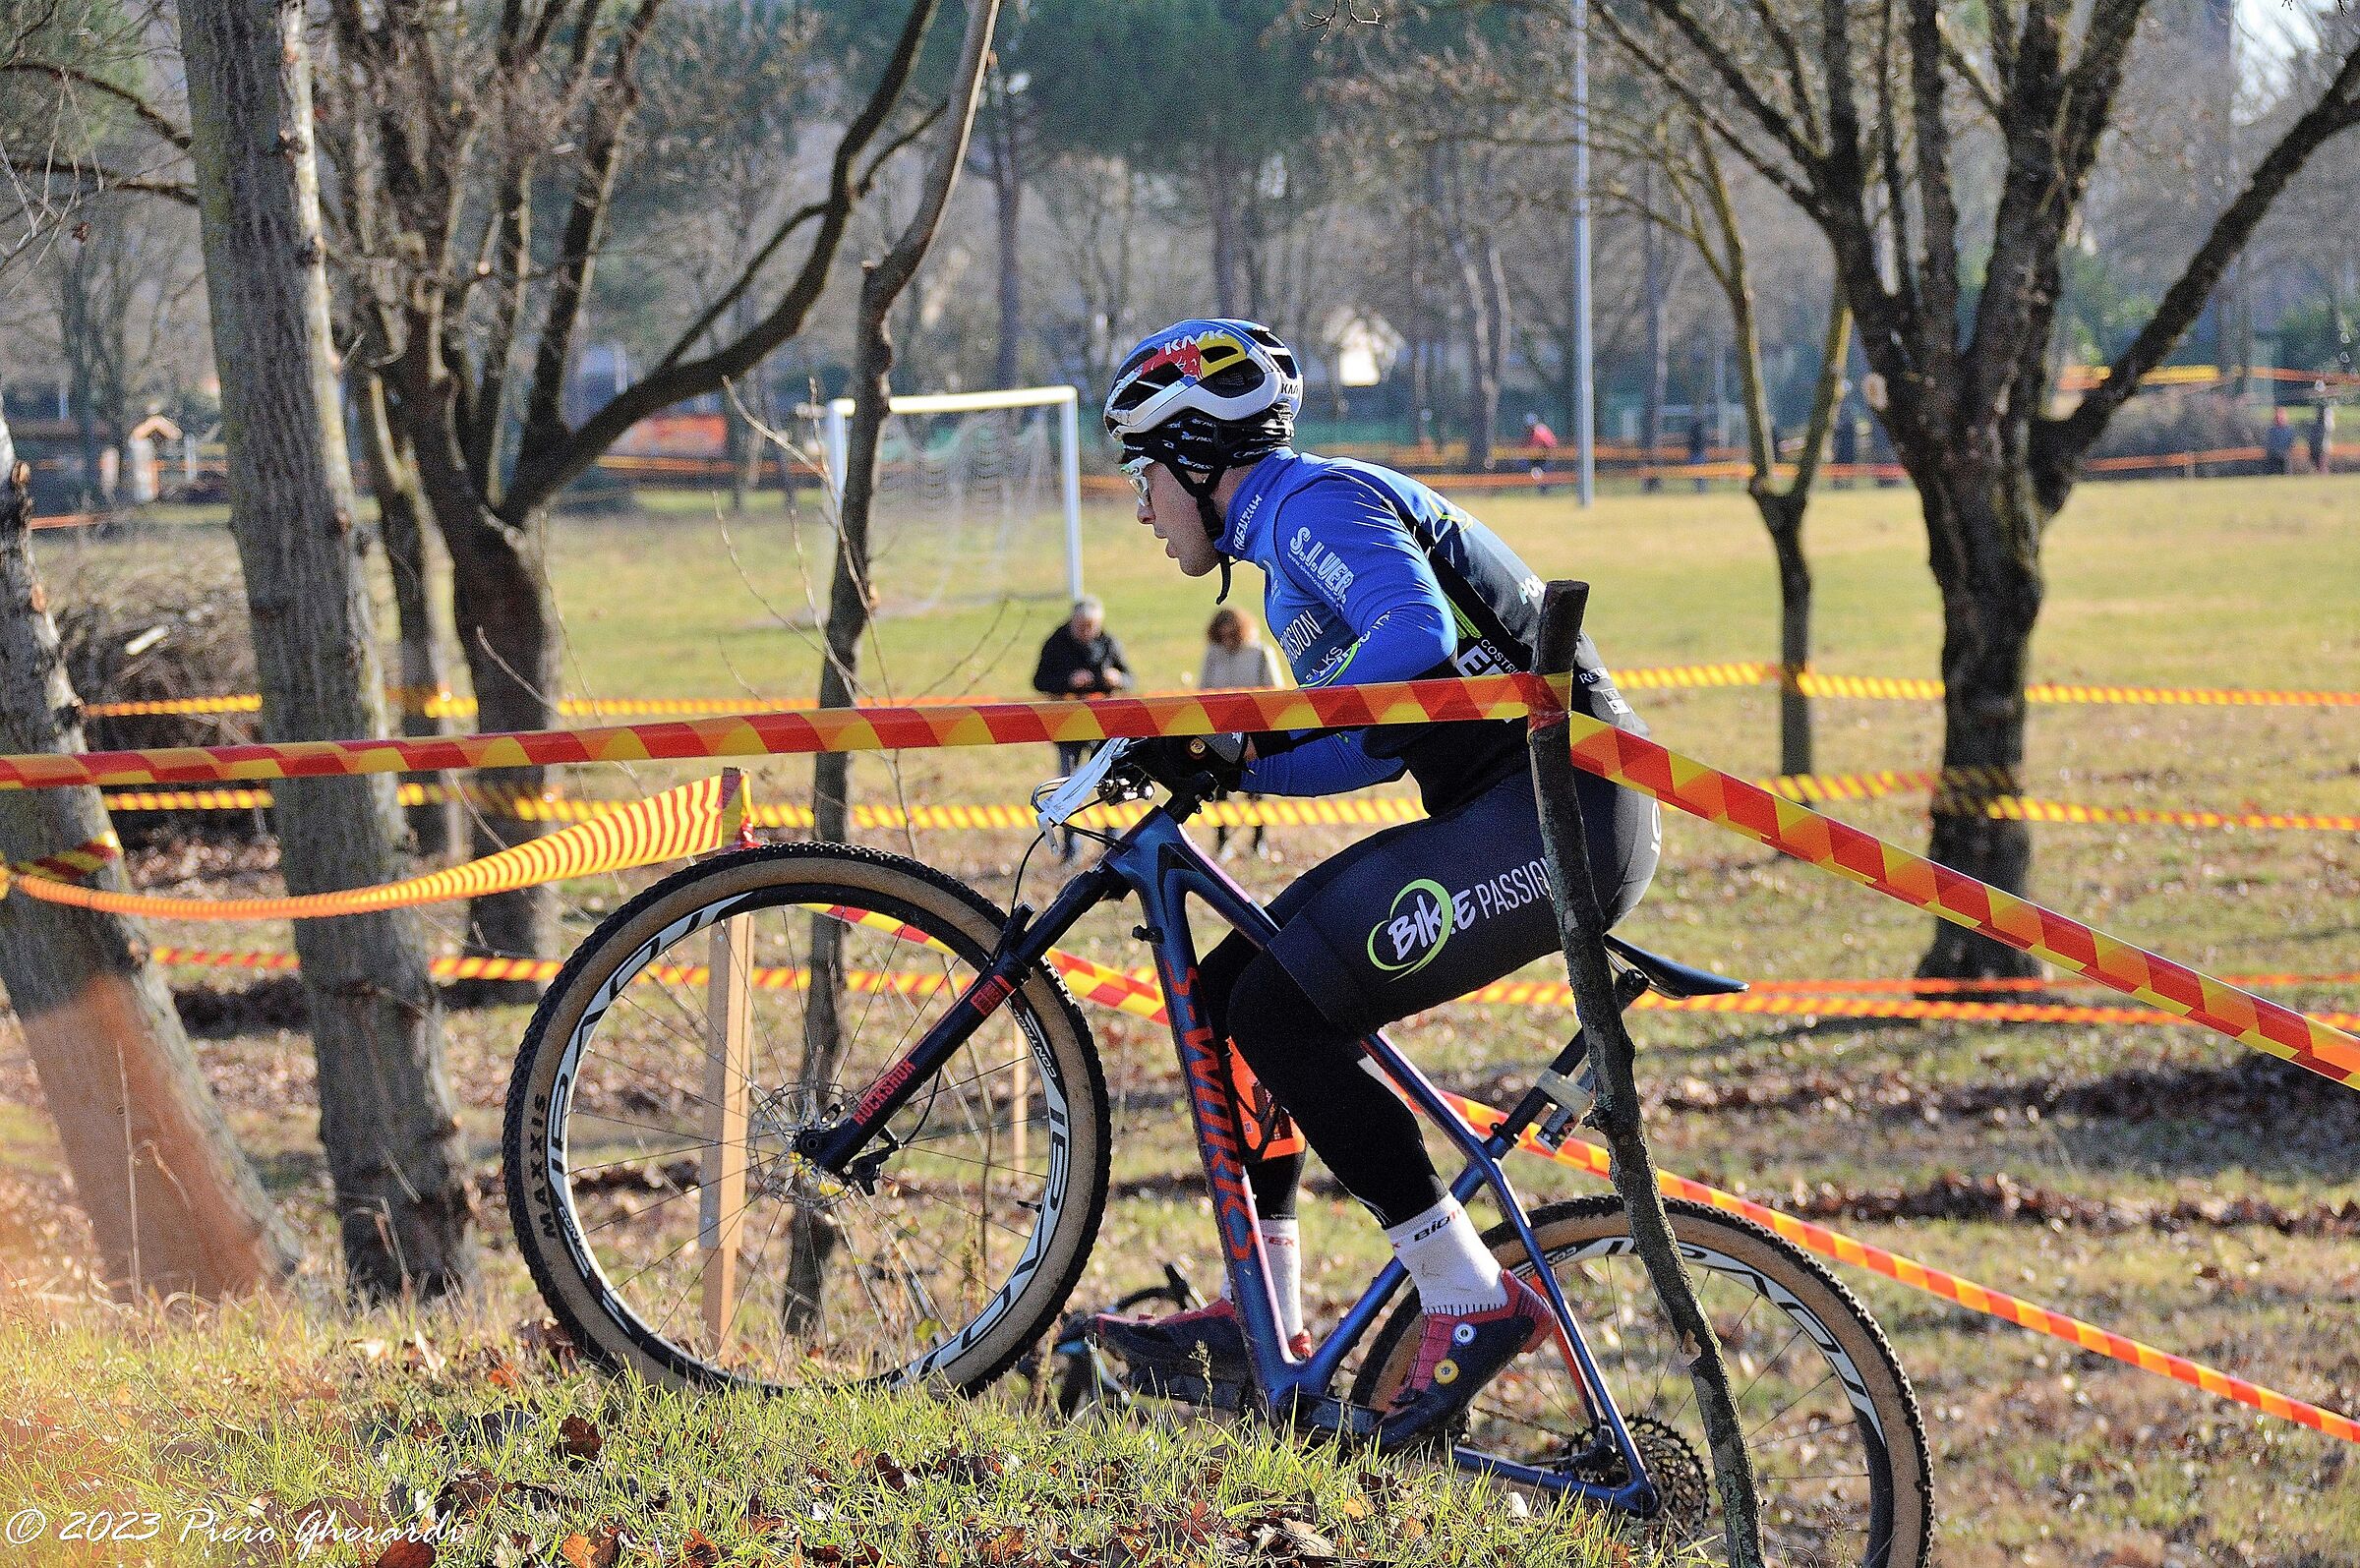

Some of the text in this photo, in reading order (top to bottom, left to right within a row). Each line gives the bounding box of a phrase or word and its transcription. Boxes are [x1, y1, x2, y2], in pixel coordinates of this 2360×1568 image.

[1164, 329, 1225, 355] KASK
[529, 1093, 559, 1239] MAXXIS
[1164, 958, 1255, 1261] S-WORKS
